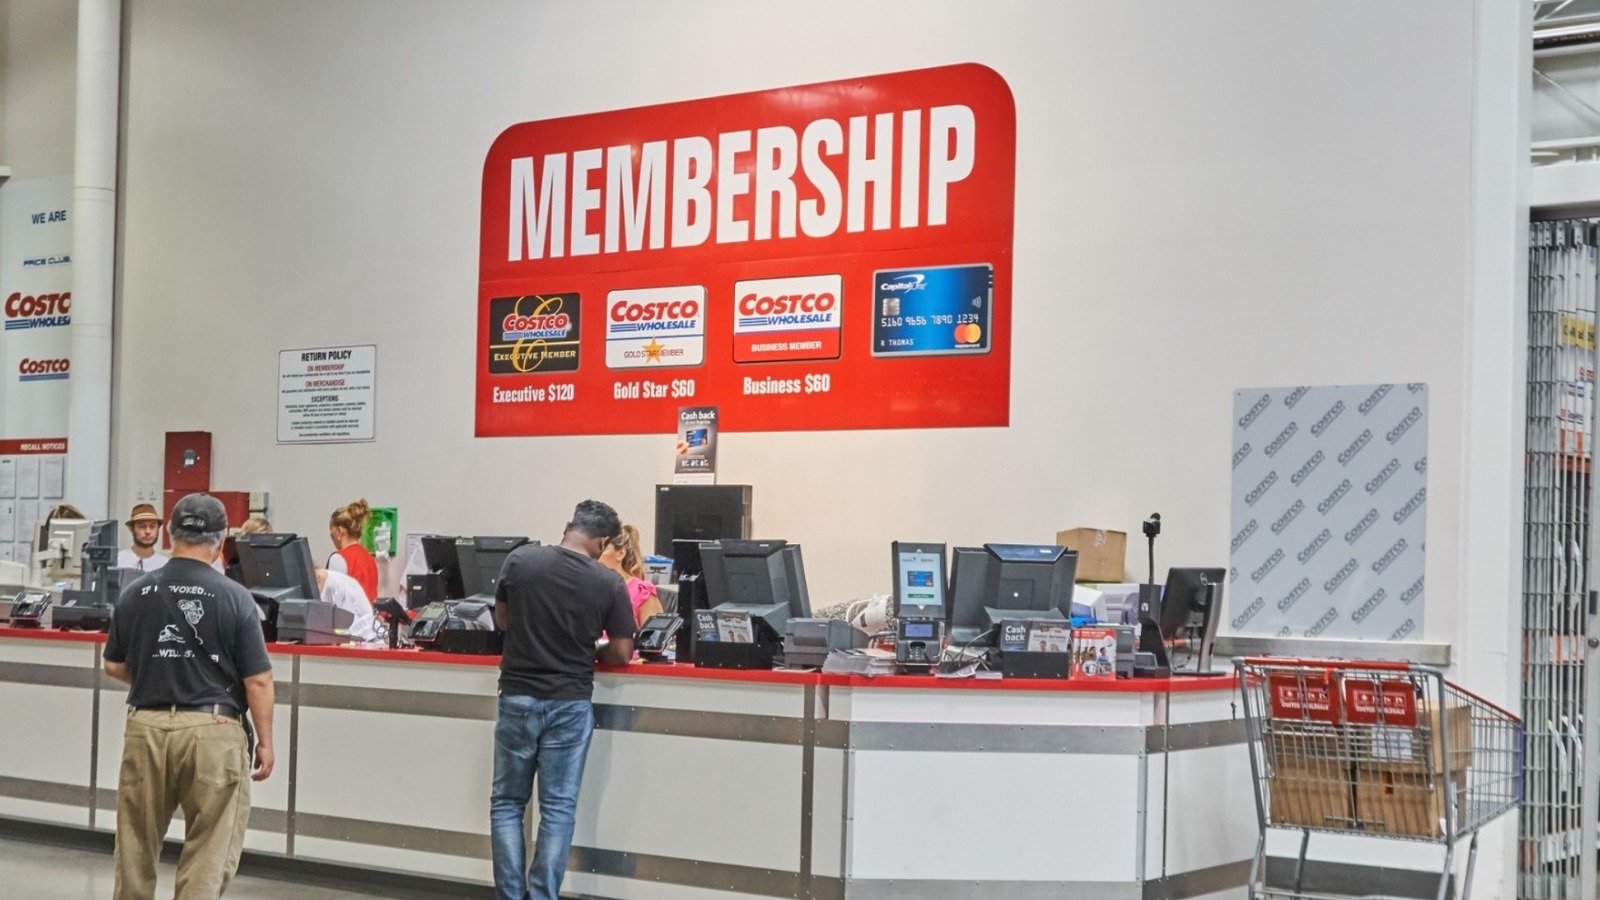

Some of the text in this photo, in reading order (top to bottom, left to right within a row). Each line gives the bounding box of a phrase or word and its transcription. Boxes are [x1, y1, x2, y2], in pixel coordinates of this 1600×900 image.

[508, 104, 976, 261] MEMBERSHIP
[32, 209, 67, 225] WE ARE
[5, 292, 71, 317] COSTC
[610, 299, 698, 322] COSTCO
[739, 292, 835, 316] COSTCO
[29, 315, 71, 328] WHOLES
[503, 313, 569, 331] COSTCO
[637, 320, 696, 331] WHOLESALE
[767, 313, 832, 325] WHOLESALE
[881, 313, 979, 328] 5160 9656 7890 1234
[523, 330, 566, 338] WHOLESALE
[301, 350, 352, 362] RETURN POLICY
[494, 350, 576, 361] EXECUTVE MEMBER
[624, 348, 684, 359] GOLD STAR MEMBER
[751, 341, 822, 352] BUSINESS MEMBER
[19, 358, 69, 374] COSTCO
[307, 364, 345, 373] ON MEMBERSHIP
[305, 379, 345, 388] ON MERCHANDISE
[493, 383, 574, 403] Executive $120
[614, 378, 695, 399] Gold Star $60
[743, 373, 831, 395] Business $60
[311, 395, 339, 403] EXCEPTIONS
[1284, 386, 1306, 406] COST
[681, 410, 715, 420] Cash back
[1238, 393, 1270, 428] COSTCO
[1310, 400, 1344, 435] COSTCO
[1386, 406, 1420, 442] COSTCO
[21, 442, 65, 451] RECALL NOTICES
[1264, 421, 1297, 456] COSTCO
[1337, 428, 1371, 464] COSTCO
[1290, 449, 1323, 484] COSTCO
[1365, 458, 1399, 493] COSTCO
[1244, 470, 1277, 504] COSTCO
[1317, 478, 1350, 514] COSTCO
[1270, 499, 1303, 533] COSTCO
[1344, 508, 1378, 543] COSTCO
[1231, 518, 1257, 550] OSTCO
[1297, 528, 1330, 562] COSTCO
[1251, 547, 1283, 582] COSTCO
[1371, 537, 1406, 573] COSTCO
[1324, 557, 1357, 592] COSTCO
[141, 585, 151, 595] IF
[1277, 577, 1310, 611] COSTCO
[1400, 575, 1424, 603] COST
[1231, 596, 1263, 629] COSTCO
[1351, 587, 1385, 622] COSTCO
[697, 613, 713, 622] Cash
[699, 621, 716, 629] back
[1004, 633, 1026, 641] back
[1005, 625, 1026, 634] Cash
[1391, 618, 1414, 640] STCO
